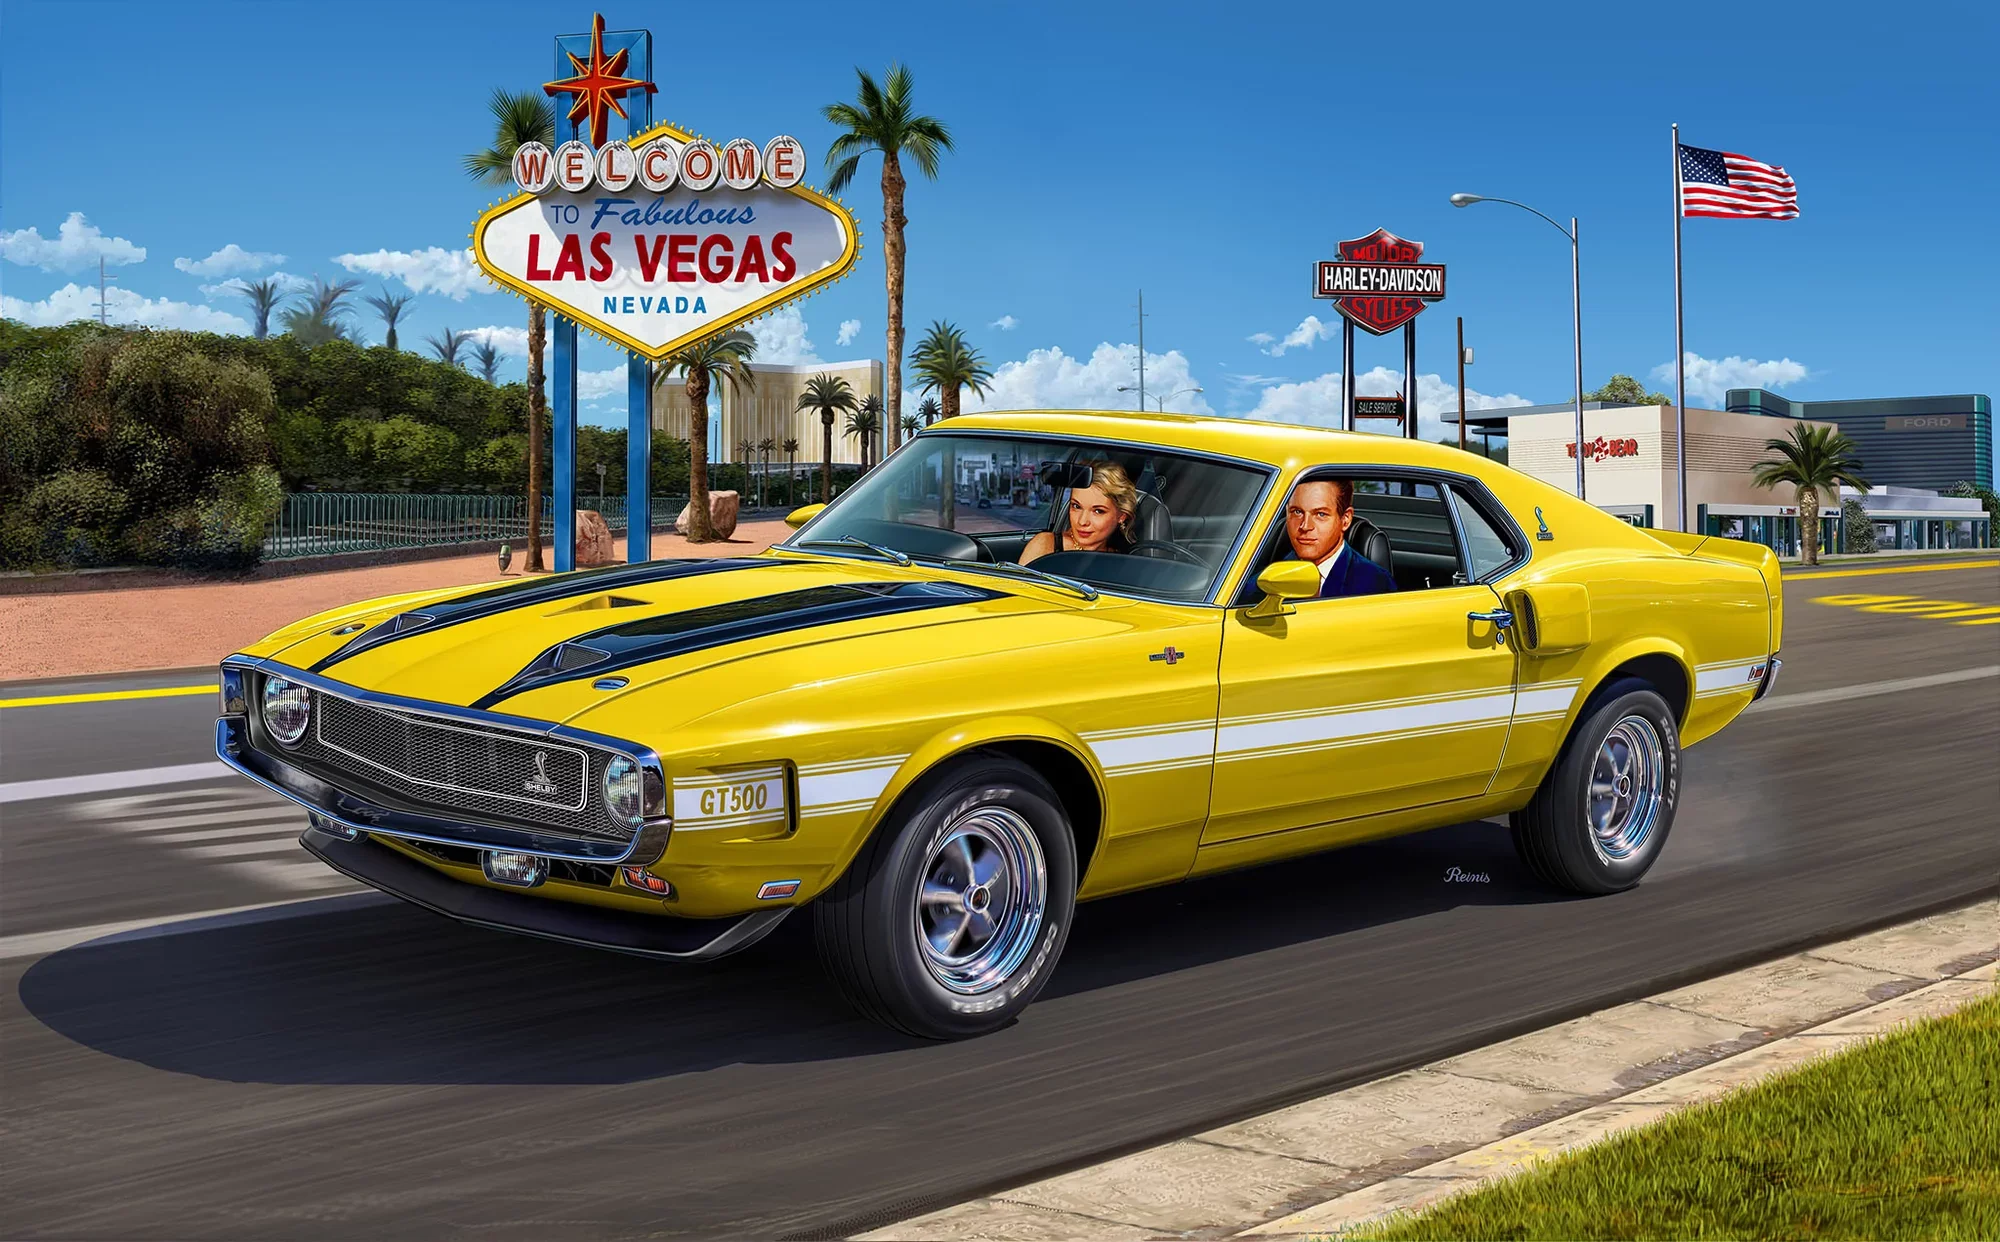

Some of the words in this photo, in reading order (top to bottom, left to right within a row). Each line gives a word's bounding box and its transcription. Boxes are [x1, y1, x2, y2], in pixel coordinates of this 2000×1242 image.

[518, 147, 795, 185] WELCOME
[550, 205, 580, 224] TO
[590, 197, 757, 230] Fabulous
[526, 232, 613, 283] LAS
[634, 231, 797, 284] VEGAS
[1353, 239, 1414, 262] MOTOR
[1324, 266, 1441, 292] HARLEY-DAVIDSON
[603, 296, 707, 314] NEVADA
[1352, 297, 1413, 323] CYCLES
[1358, 401, 1373, 413] SALE
[1374, 402, 1397, 414] SERVICE
[1904, 417, 1951, 428] FORD
[1609, 438, 1639, 457] BEAR
[1660, 716, 1677, 775] RADIAL
[525, 782, 556, 793] SHELBY
[700, 783, 767, 815] GT500
[1443, 866, 1490, 884] Reinis
